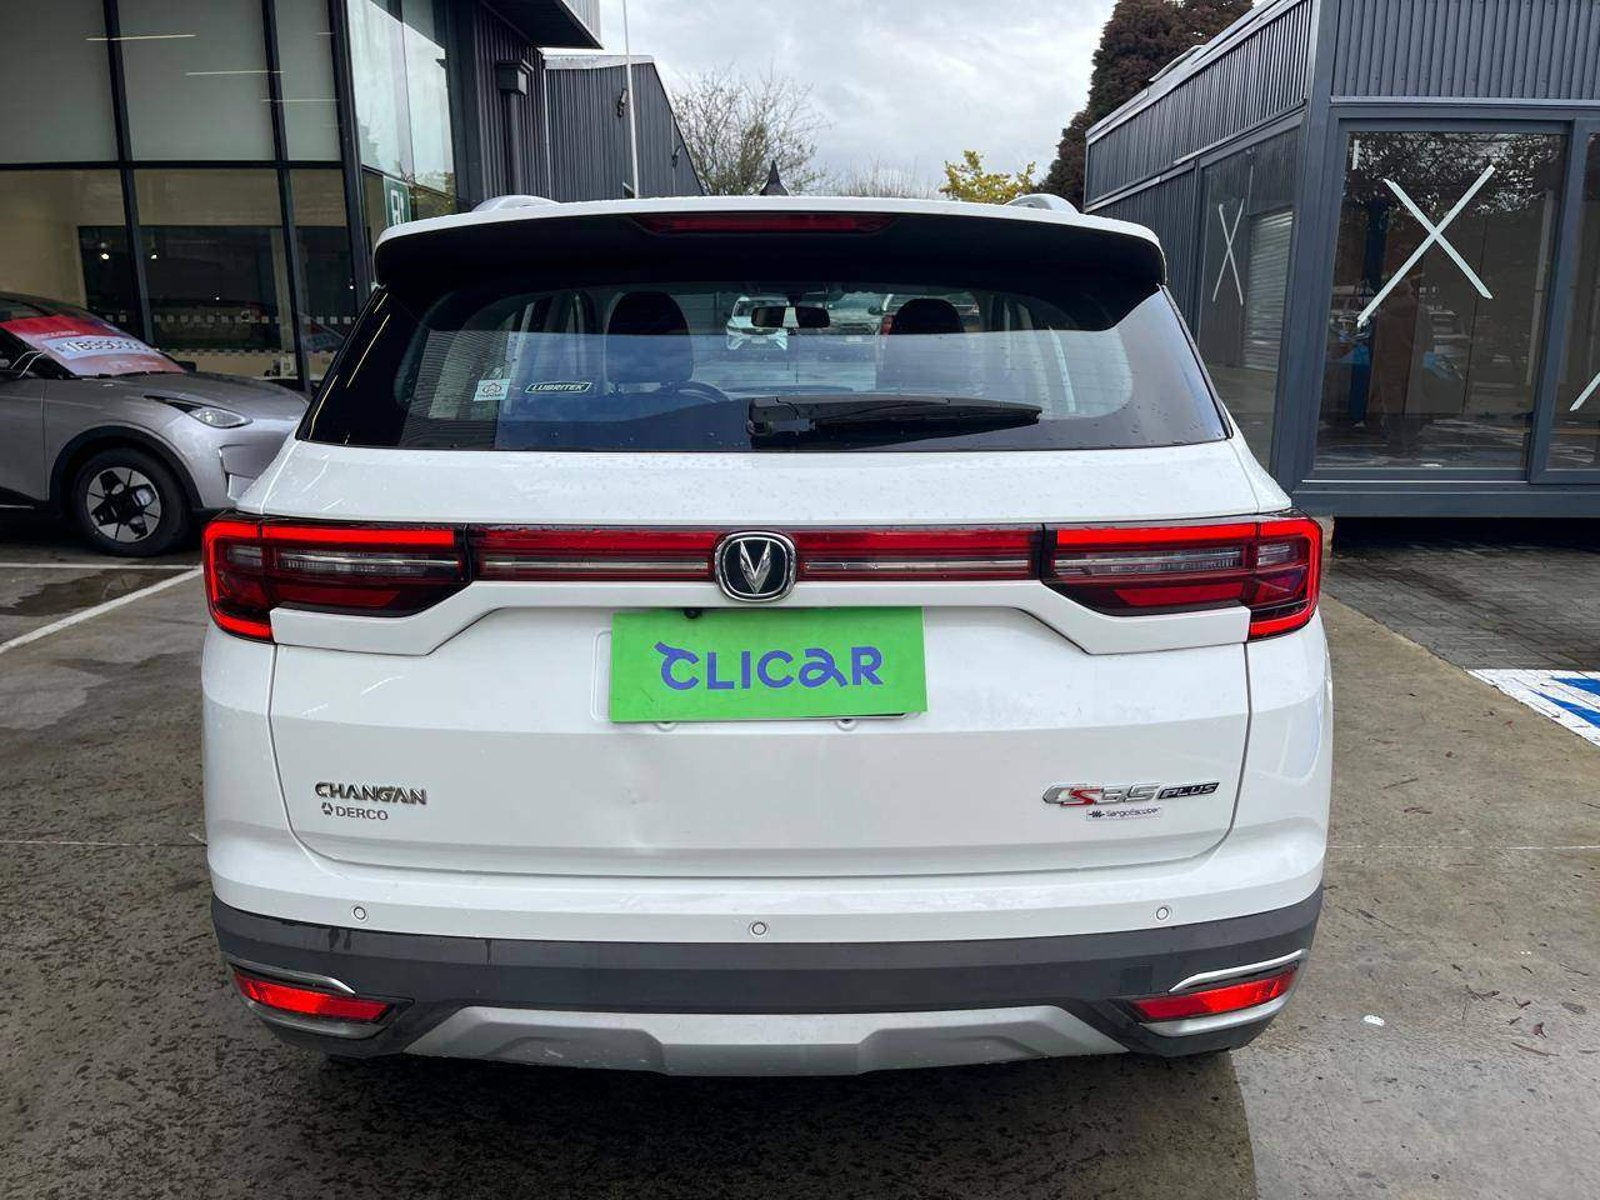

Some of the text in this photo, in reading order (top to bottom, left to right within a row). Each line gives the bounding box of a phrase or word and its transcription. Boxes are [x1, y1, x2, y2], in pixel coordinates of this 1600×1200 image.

[531, 383, 585, 391] LUBRITEK
[315, 781, 428, 805] CHANGAN
[1158, 782, 1220, 800] PLUS
[335, 806, 389, 821] DERCO
